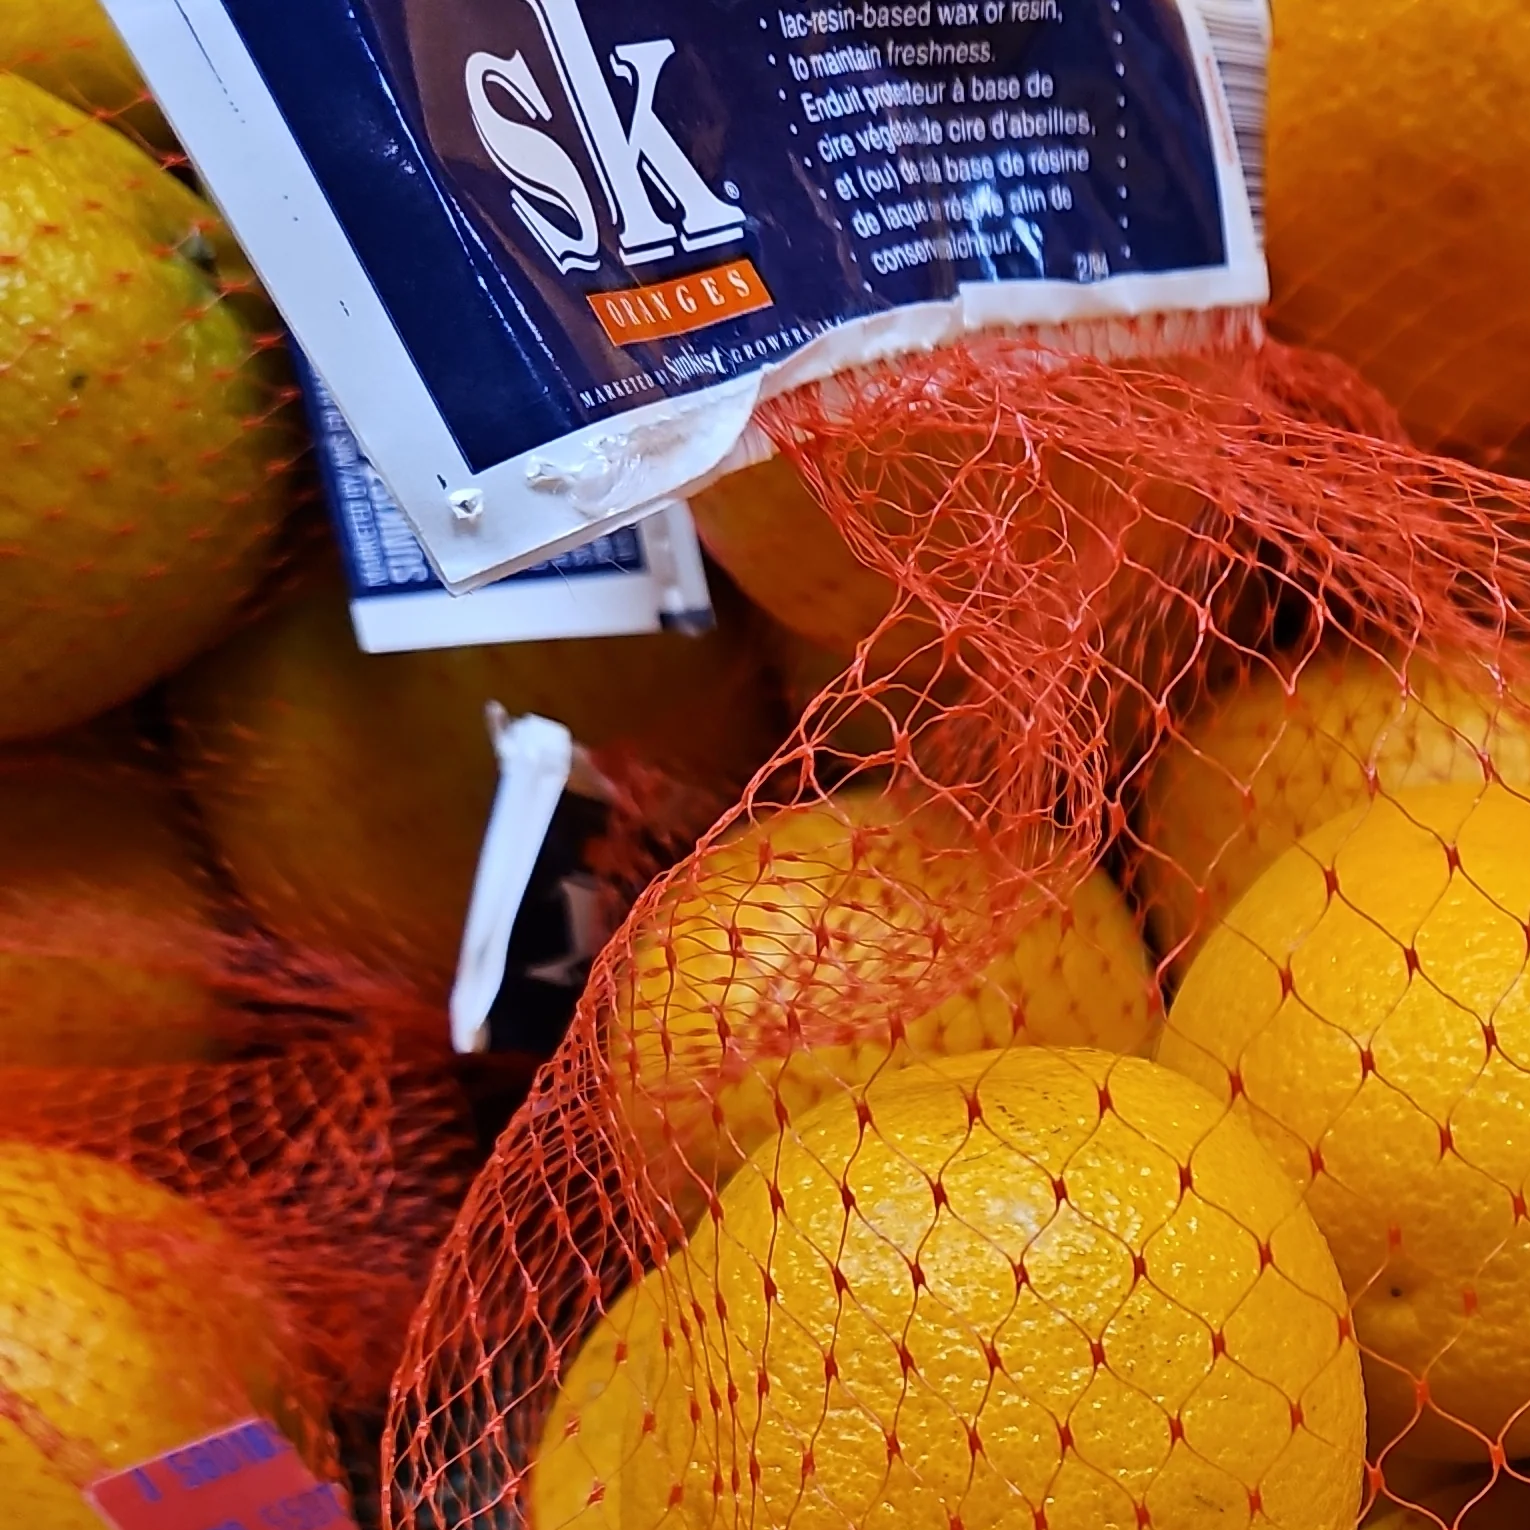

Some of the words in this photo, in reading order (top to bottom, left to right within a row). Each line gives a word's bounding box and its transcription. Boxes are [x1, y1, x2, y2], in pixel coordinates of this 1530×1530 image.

[779, 1, 931, 39] lac-resin-based
[937, 3, 979, 26] wax
[985, 0, 1006, 24] or
[1011, 0, 1063, 23] resin,
[788, 53, 809, 81] to
[810, 41, 882, 79] maintain
[887, 39, 997, 67] freshness.
[801, 86, 866, 123] Enduit
[952, 77, 965, 103] à
[972, 75, 1020, 102] base
[1027, 70, 1054, 98] de
[817, 131, 857, 164] cire
[948, 115, 986, 144] cire
[991, 111, 1097, 142] d'abeilles,
[835, 171, 860, 201] et
[857, 160, 901, 200] (ou)
[944, 153, 995, 184] base
[1000, 150, 1025, 178] de
[1030, 148, 1090, 177] résine
[852, 208, 881, 239] de
[1009, 185, 1048, 215] afin
[1051, 183, 1073, 212] de
[604, 268, 751, 329] ORANGES
[654, 369, 671, 386] BY
[662, 343, 728, 386] Sunkist
[579, 373, 655, 408] MARKETED
